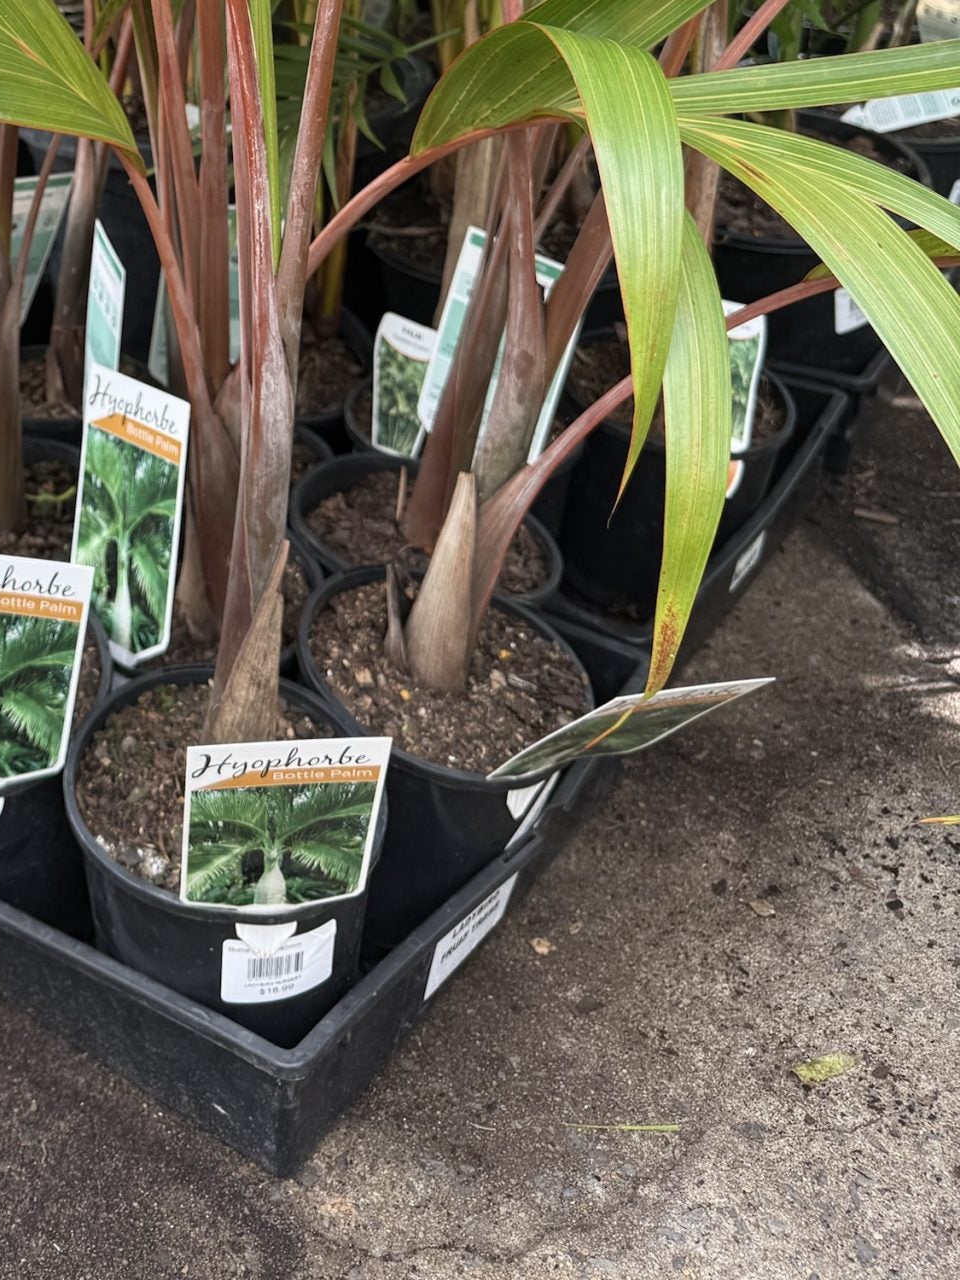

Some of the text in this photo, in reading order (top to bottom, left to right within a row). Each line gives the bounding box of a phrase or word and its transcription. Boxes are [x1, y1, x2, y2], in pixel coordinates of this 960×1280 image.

[90, 374, 178, 434] Hyophorbe
[126, 422, 178, 454] Bottle Palm
[40, 601, 77, 615] Palm
[191, 746, 371, 778] Hyophorbe
[272, 768, 373, 781] Bottle Palm
